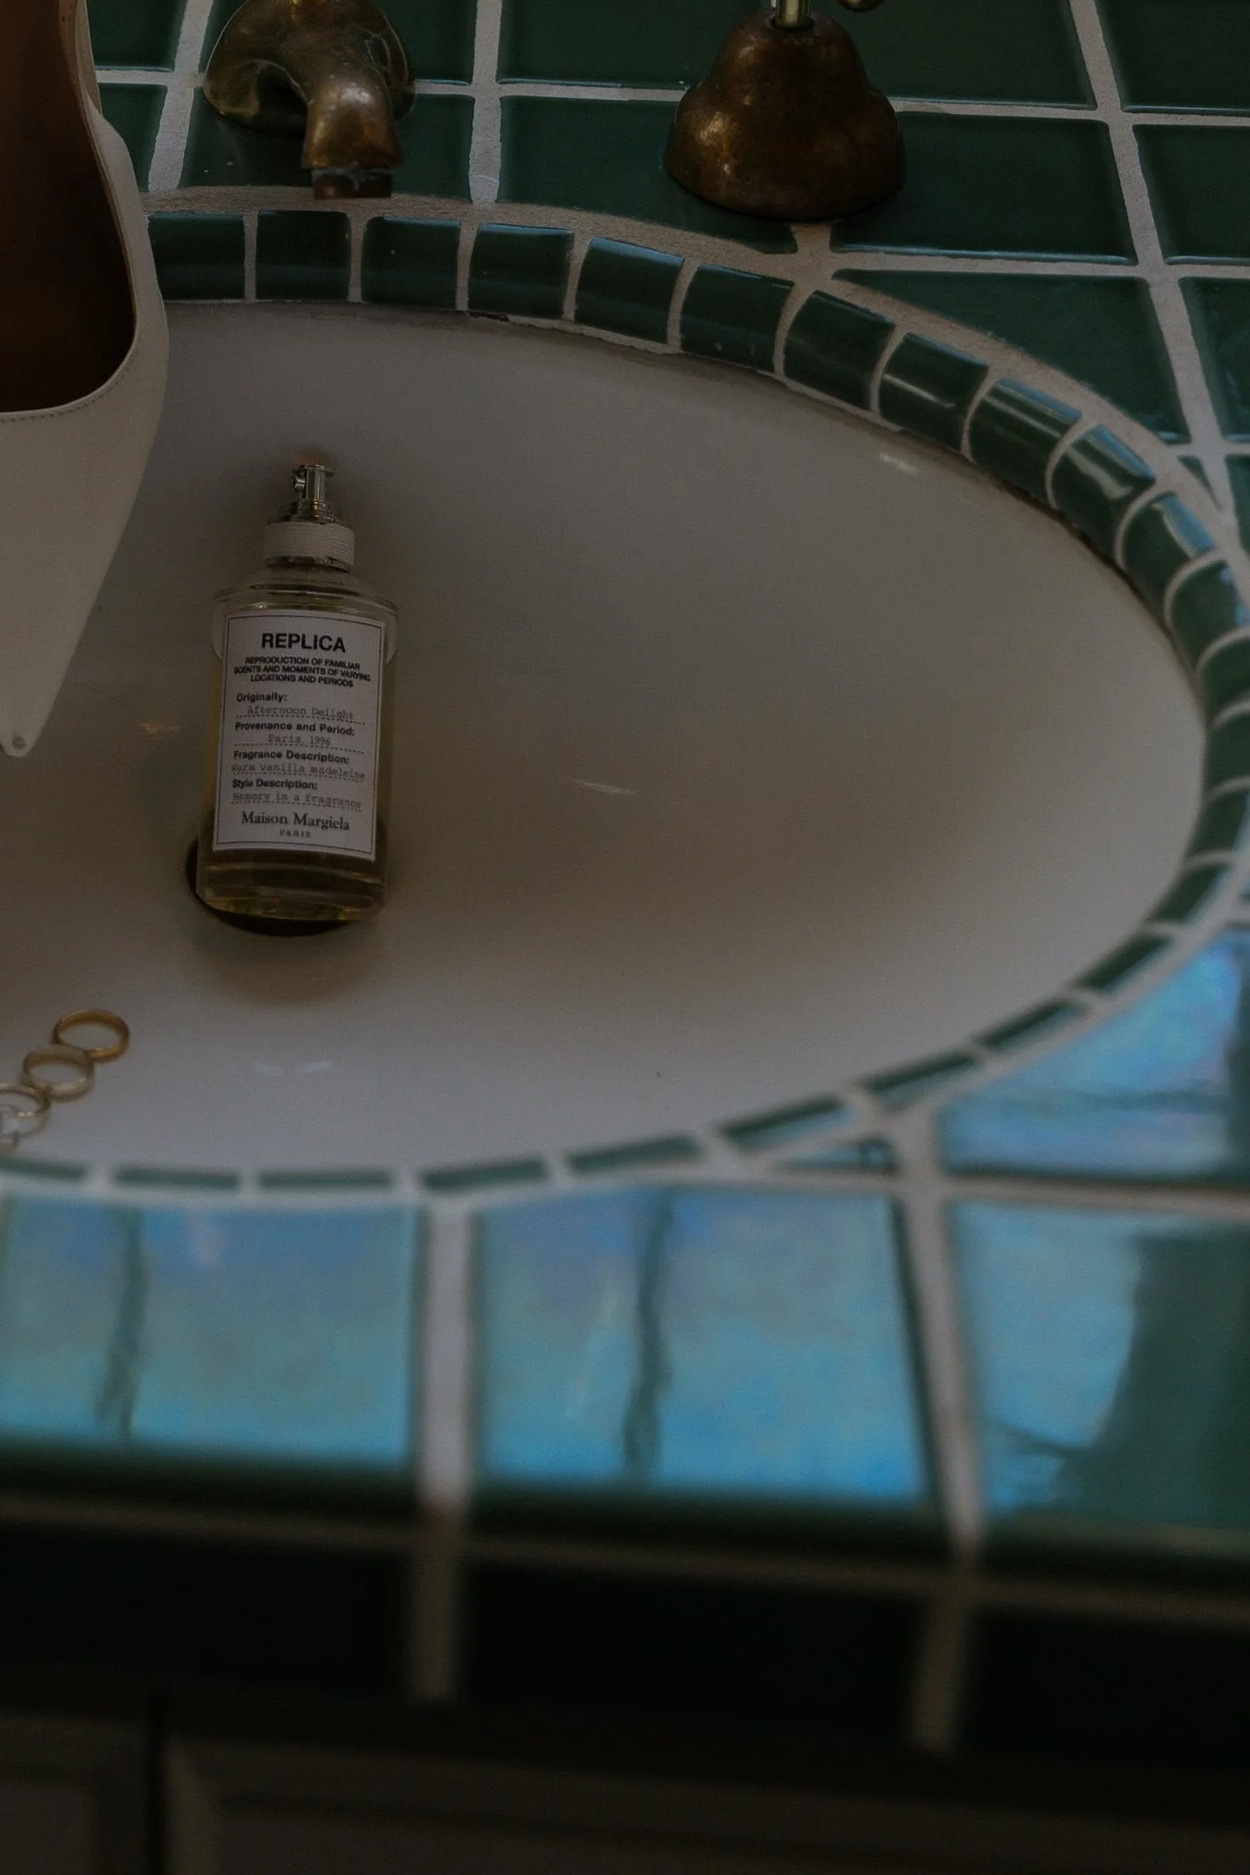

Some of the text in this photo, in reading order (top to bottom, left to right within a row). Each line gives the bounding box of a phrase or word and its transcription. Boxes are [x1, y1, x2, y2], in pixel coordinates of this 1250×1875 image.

[262, 633, 346, 653] REPLICA
[245, 657, 309, 665] REPRODUCTION
[325, 659, 360, 670] FAMILIAR
[234, 666, 261, 674] SCENTS
[282, 666, 326, 674] MOMENTS
[340, 670, 371, 681] VARYING
[251, 674, 354, 687] LOCATIONS AND PERIODS
[236, 692, 287, 702] Originally:
[247, 706, 354, 720] Afternoon Delight
[235, 722, 355, 736] Provenance and Period:
[310, 736, 332, 745] 1996
[234, 750, 350, 764] Fragrance Description:
[231, 763, 365, 779] Warm vanilla madeleine
[232, 779, 318, 789] Style Description:
[232, 791, 271, 802] Memory
[275, 791, 288, 801] in
[305, 792, 362, 808] fragrance
[241, 811, 350, 830] Maison Margiela
[280, 829, 311, 838] PARIS
